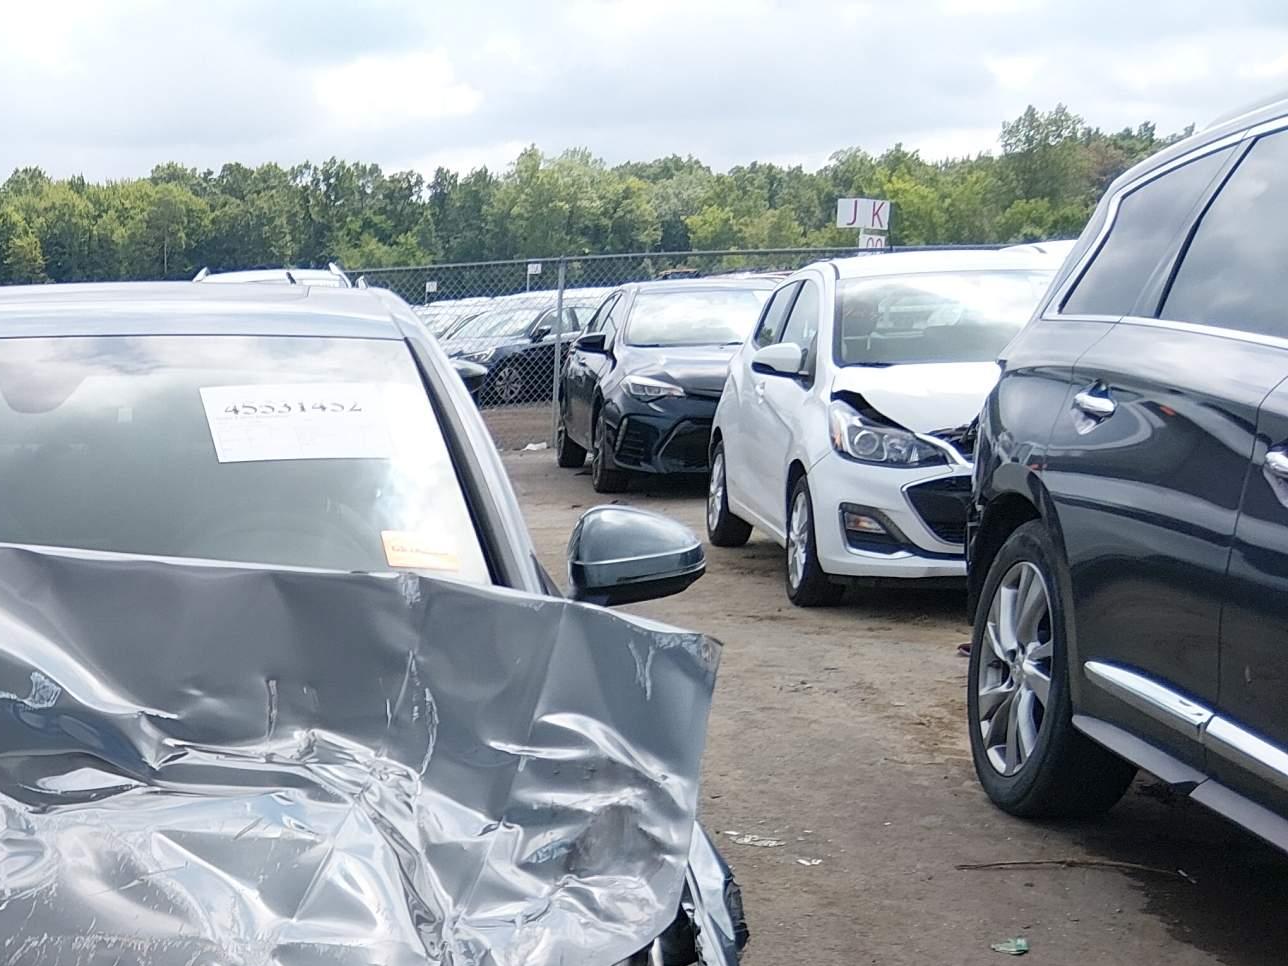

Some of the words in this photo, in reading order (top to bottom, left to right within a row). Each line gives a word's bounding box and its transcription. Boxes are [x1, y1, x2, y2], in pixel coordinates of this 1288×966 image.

[846, 200, 857, 225] J
[872, 201, 885, 227] K
[223, 400, 363, 416] 45531452
